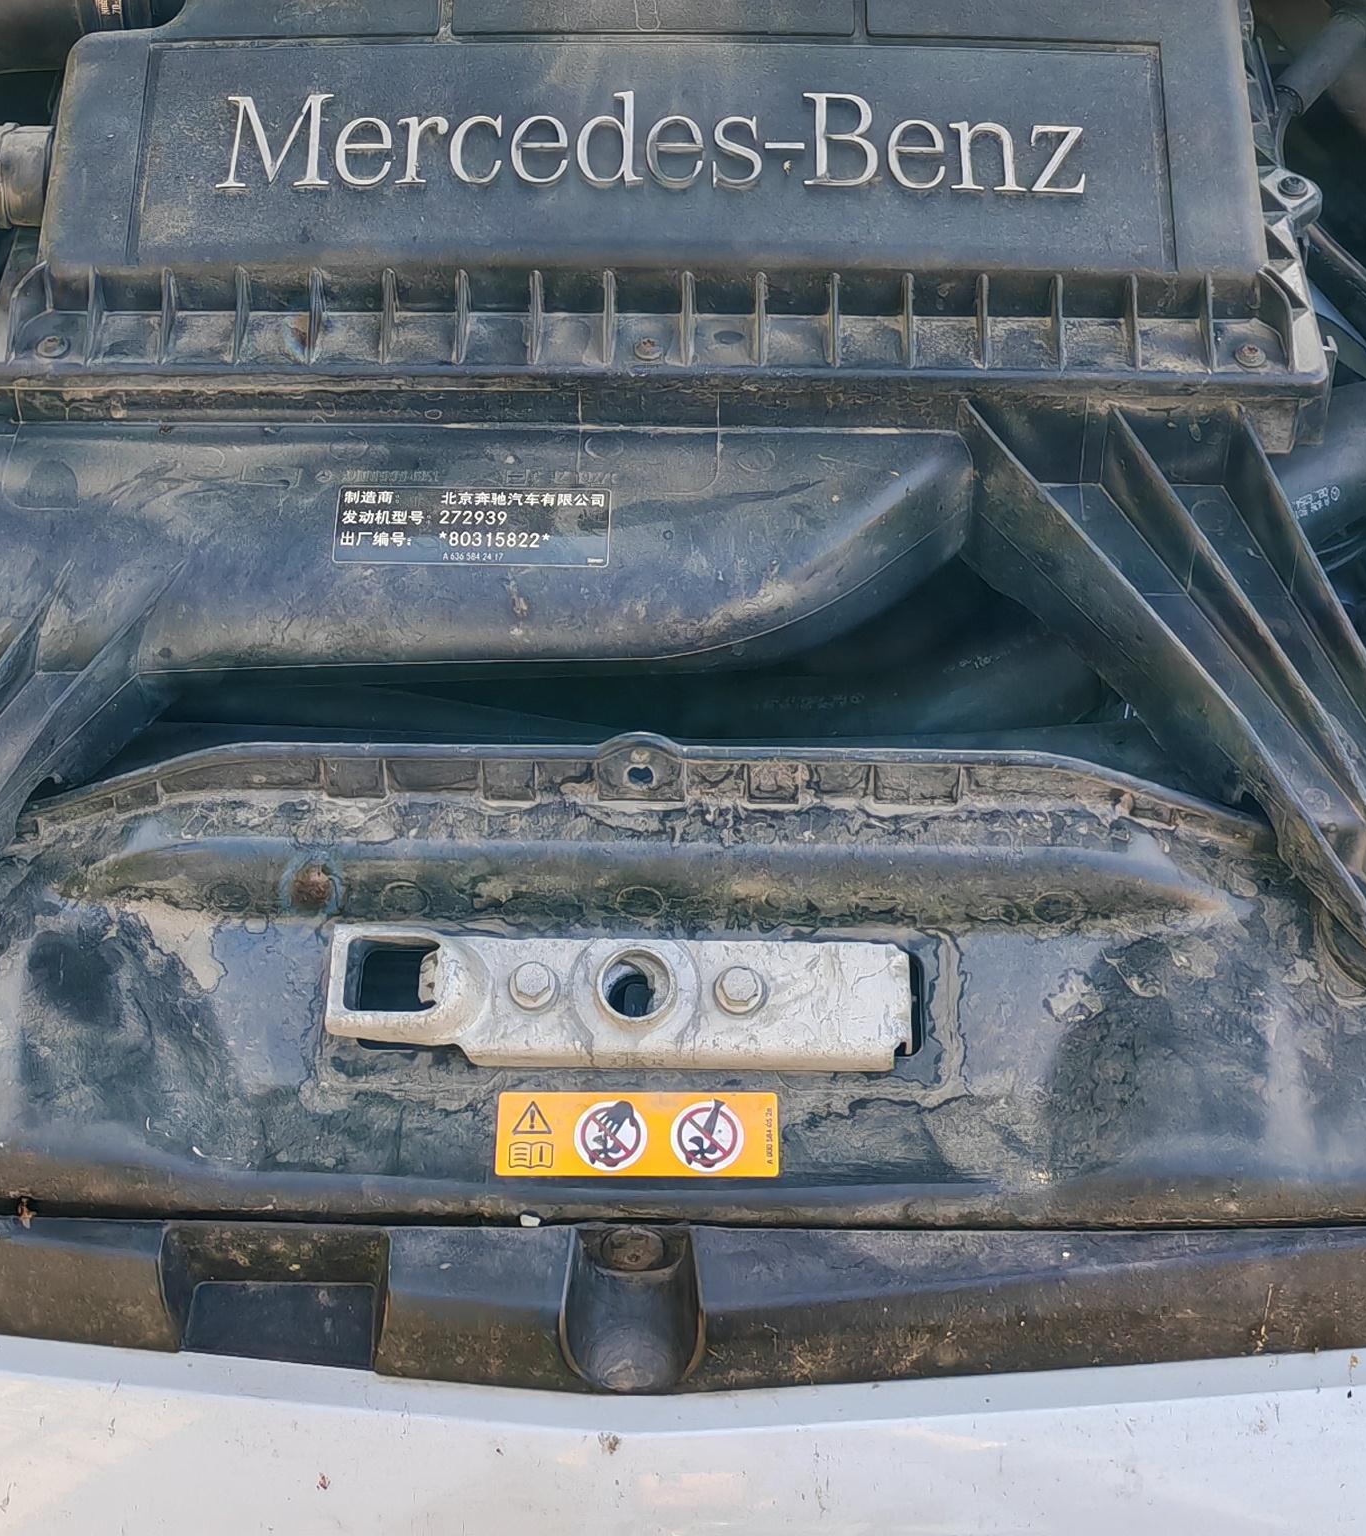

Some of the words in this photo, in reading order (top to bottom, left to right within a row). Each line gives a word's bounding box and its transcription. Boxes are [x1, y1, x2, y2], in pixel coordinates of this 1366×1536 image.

[216, 90, 1088, 198] Mercedes-Benz
[441, 491, 606, 508] 北京奔驰汽车有限公司
[439, 510, 508, 526] 272939
